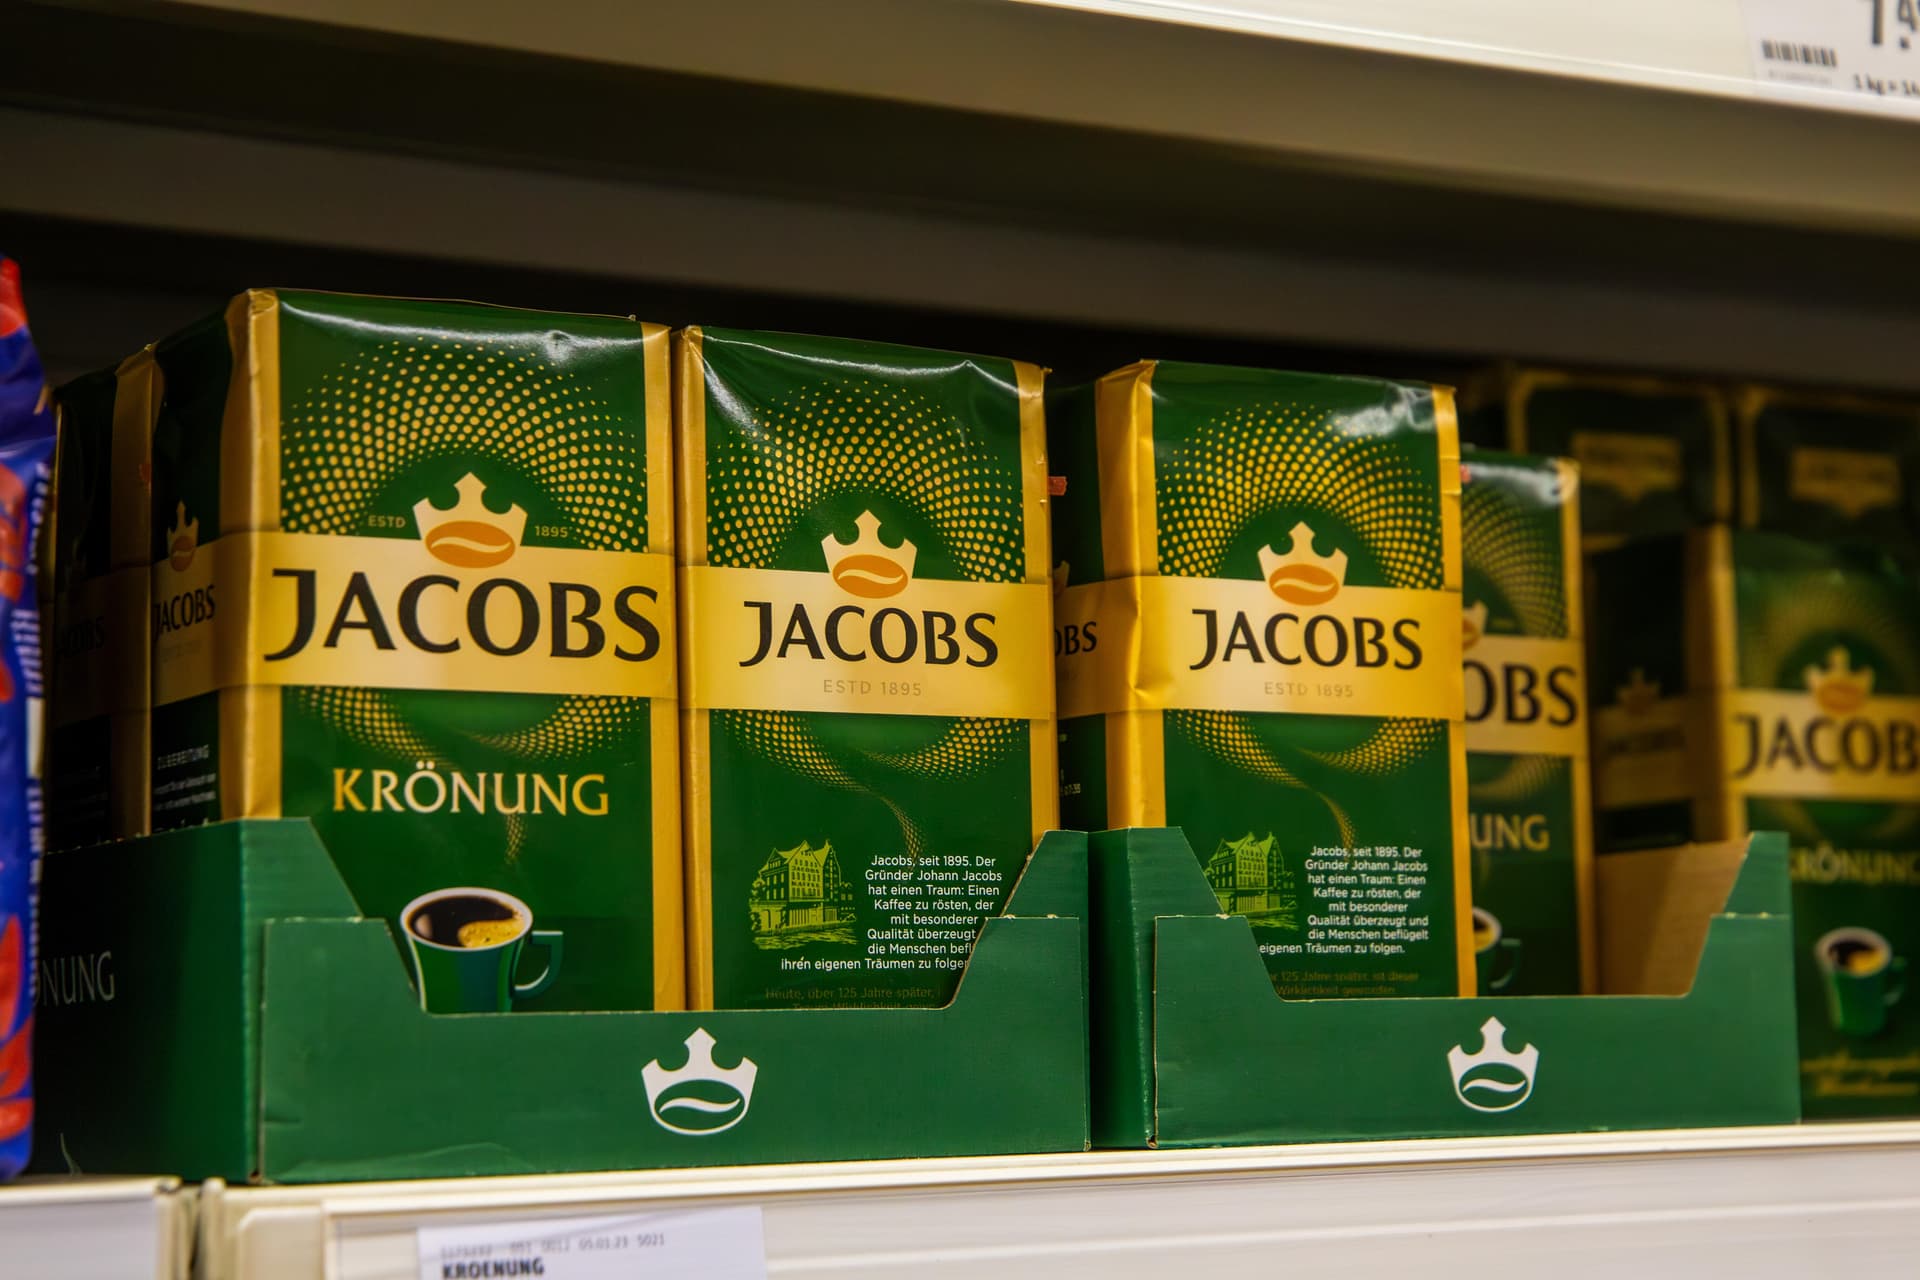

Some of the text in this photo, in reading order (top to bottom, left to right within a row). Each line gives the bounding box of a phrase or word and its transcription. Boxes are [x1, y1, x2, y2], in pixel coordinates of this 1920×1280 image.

[367, 515, 406, 529] ESTD
[534, 525, 568, 538] 1895
[264, 568, 662, 663] JACOBS
[739, 600, 998, 668] JACOBS
[1189, 608, 1423, 670] JACOBS
[823, 679, 922, 697] ESTD 1895
[1264, 682, 1354, 697] ESTD 1895
[332, 761, 609, 816] KRÖNUNG
[1310, 846, 1423, 858] Jacobs, seit 1895. Der
[871, 855, 996, 868] Jacobs, seit 1895. Der
[1305, 859, 1428, 872] Gründer Johann Jacobs
[865, 869, 1002, 882] Gründer Johann Jacobs
[1308, 873, 1325, 885] hat
[1328, 874, 1358, 885] einen
[1397, 874, 1426, 885] Einen
[868, 884, 1000, 896] hat einen Traum: Einen
[1313, 887, 1422, 900] Kaffee zu rösten, der
[874, 899, 994, 912] Kaffee zu rösten, der
[1328, 901, 1408, 912] mit besonderer
[890, 914, 978, 925] mit besonderer
[1307, 914, 1429, 928] Qualität überzeugt und
[867, 929, 977, 942] Qualität überzeugt
[1308, 928, 1429, 942] die Menschen beflügelt
[867, 943, 886, 955] die
[889, 943, 947, 955] Menschen
[1259, 942, 1405, 955] eigenen Träumen zu folgen.
[814, 958, 861, 972] eigenen
[864, 957, 915, 969] Träumen
[918, 959, 931, 969] zu
